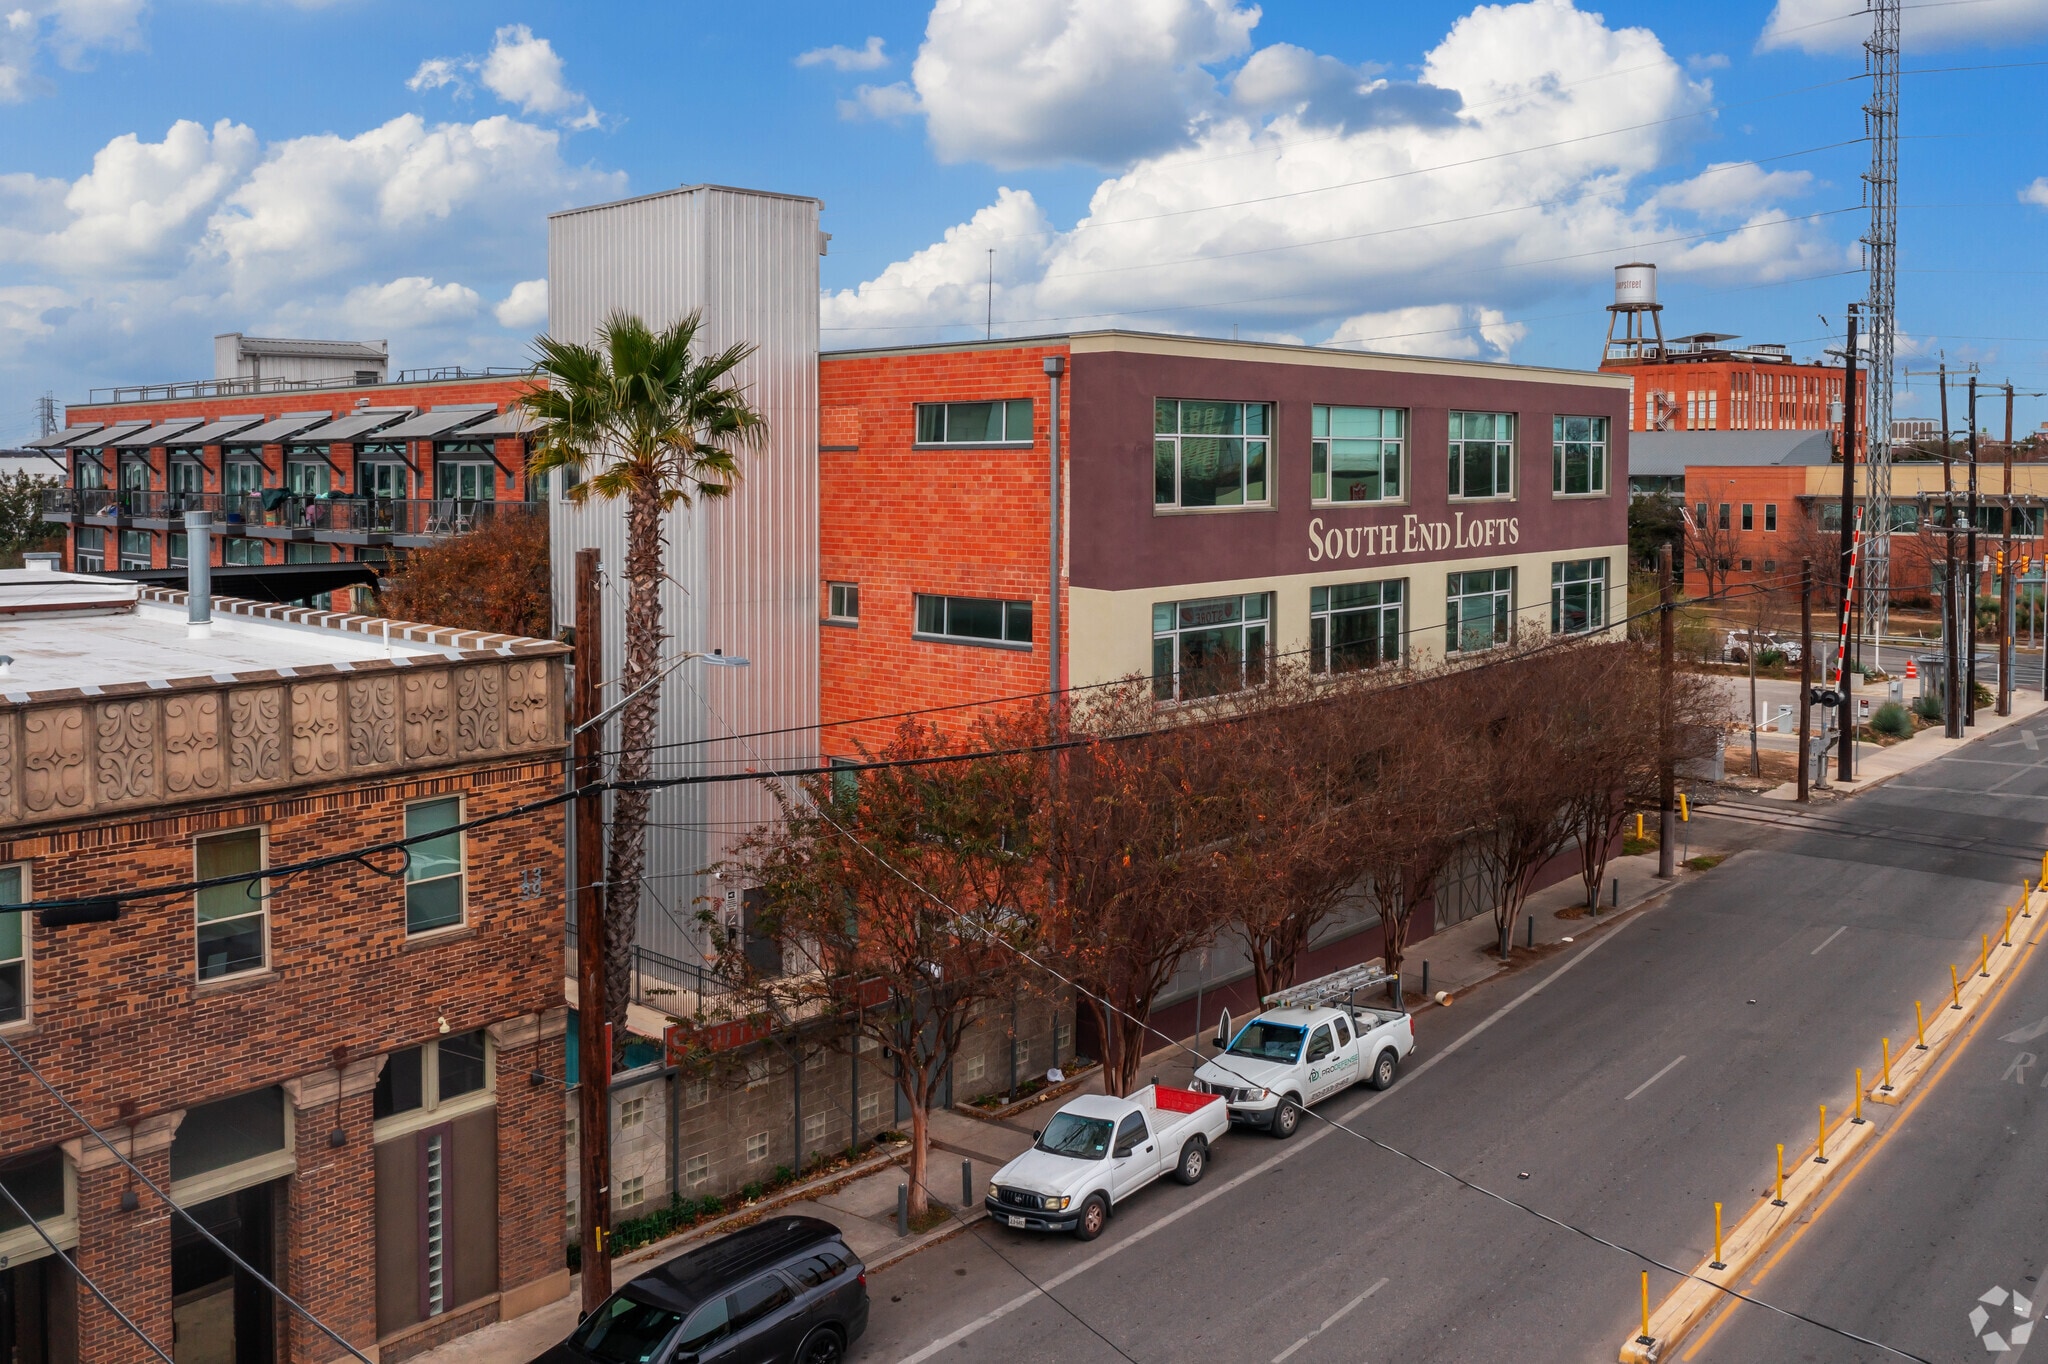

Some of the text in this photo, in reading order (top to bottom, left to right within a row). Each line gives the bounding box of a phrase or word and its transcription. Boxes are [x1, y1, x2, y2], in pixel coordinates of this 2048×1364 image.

[1308, 511, 1519, 562] SOUTH END LOFTS
